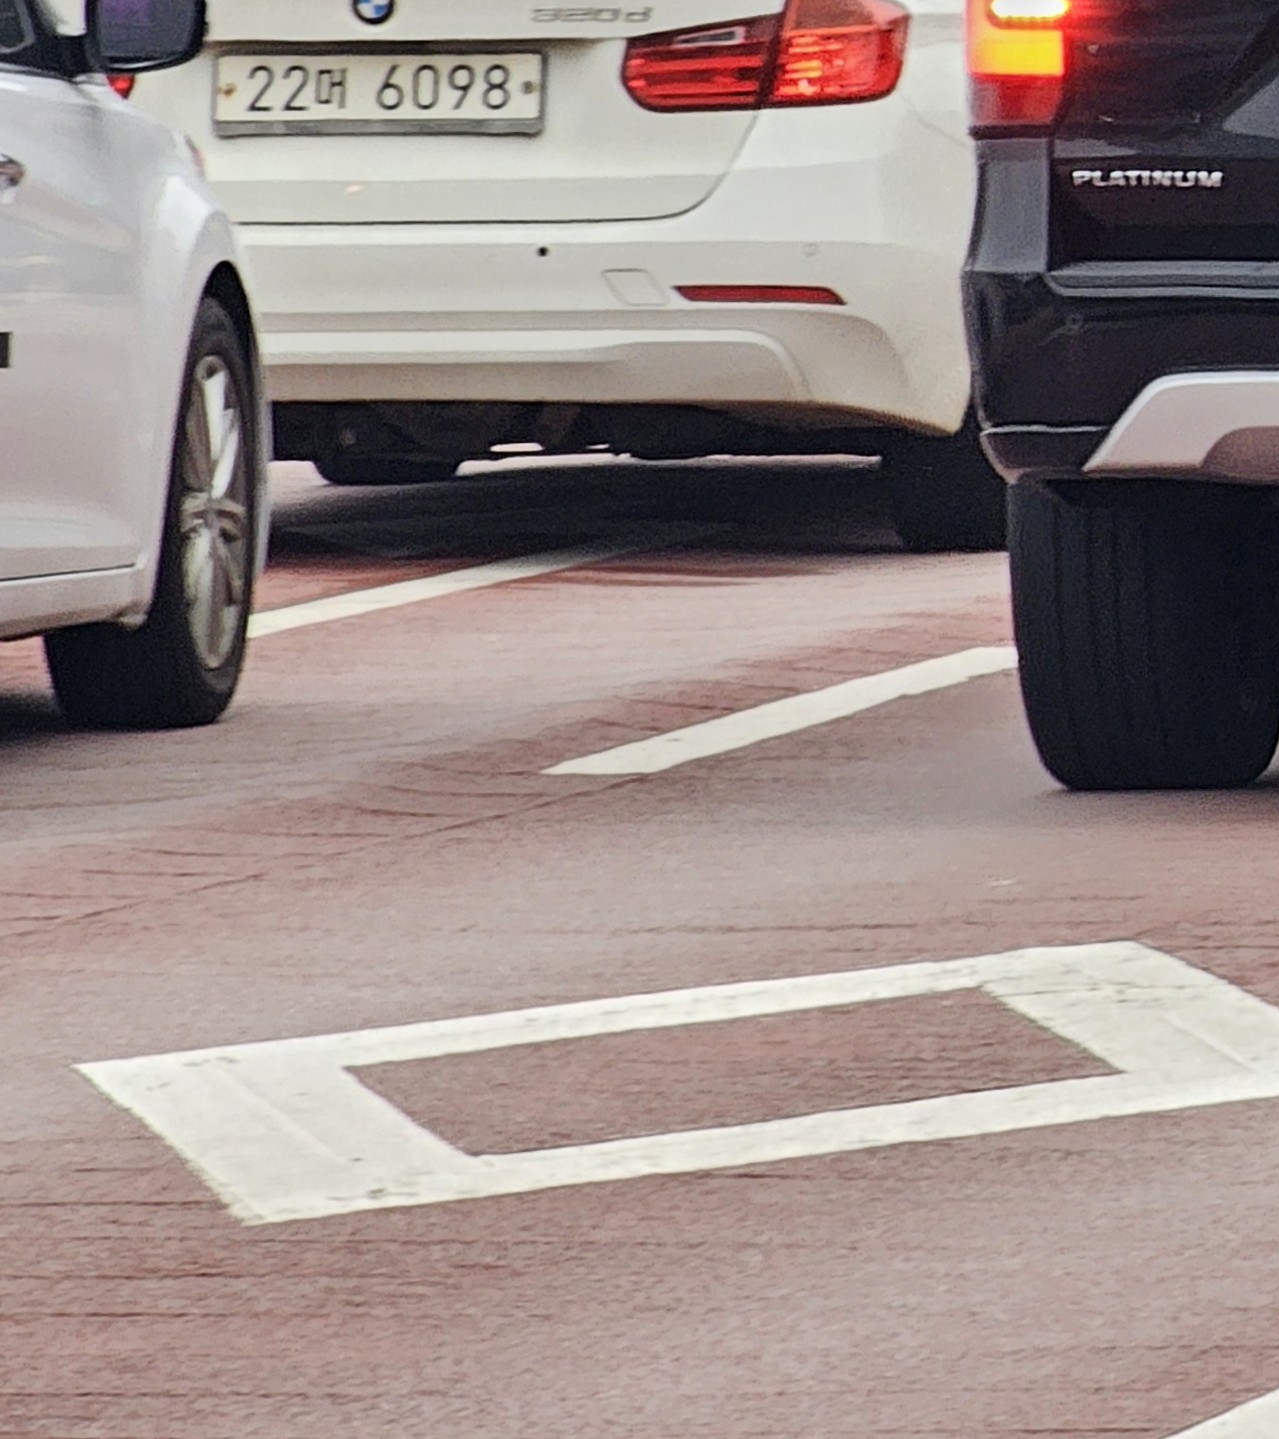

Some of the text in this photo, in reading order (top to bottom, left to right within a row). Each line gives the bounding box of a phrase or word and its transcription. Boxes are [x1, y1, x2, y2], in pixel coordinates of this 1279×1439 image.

[246, 64, 513, 111] 22머 6098
[1072, 170, 1223, 187] PLATINUM
